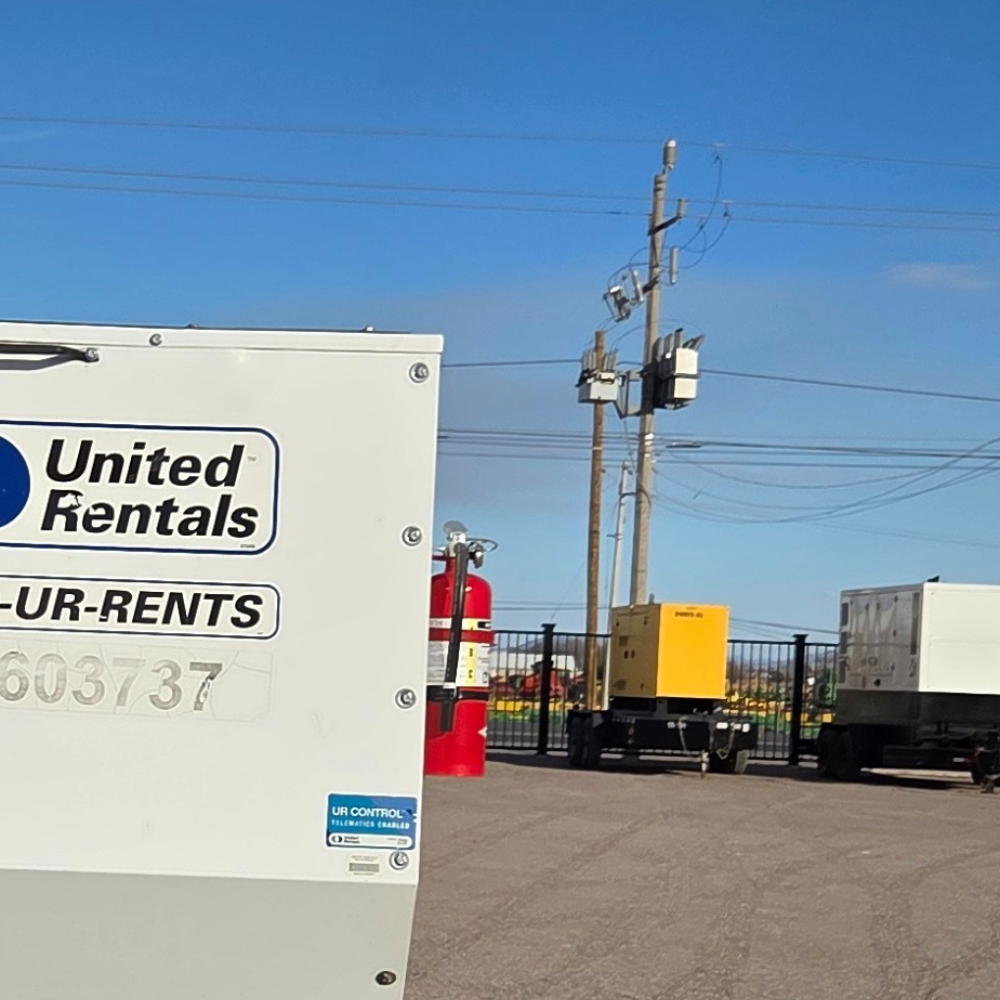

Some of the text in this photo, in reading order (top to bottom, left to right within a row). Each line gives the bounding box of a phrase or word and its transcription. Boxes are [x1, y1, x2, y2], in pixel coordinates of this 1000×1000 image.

[46, 439, 245, 487] United
[41, 489, 259, 538] Rentals
[331, 819, 410, 830] TELEMATICS ENABLED
[332, 806, 403, 818] UR CONTROL
